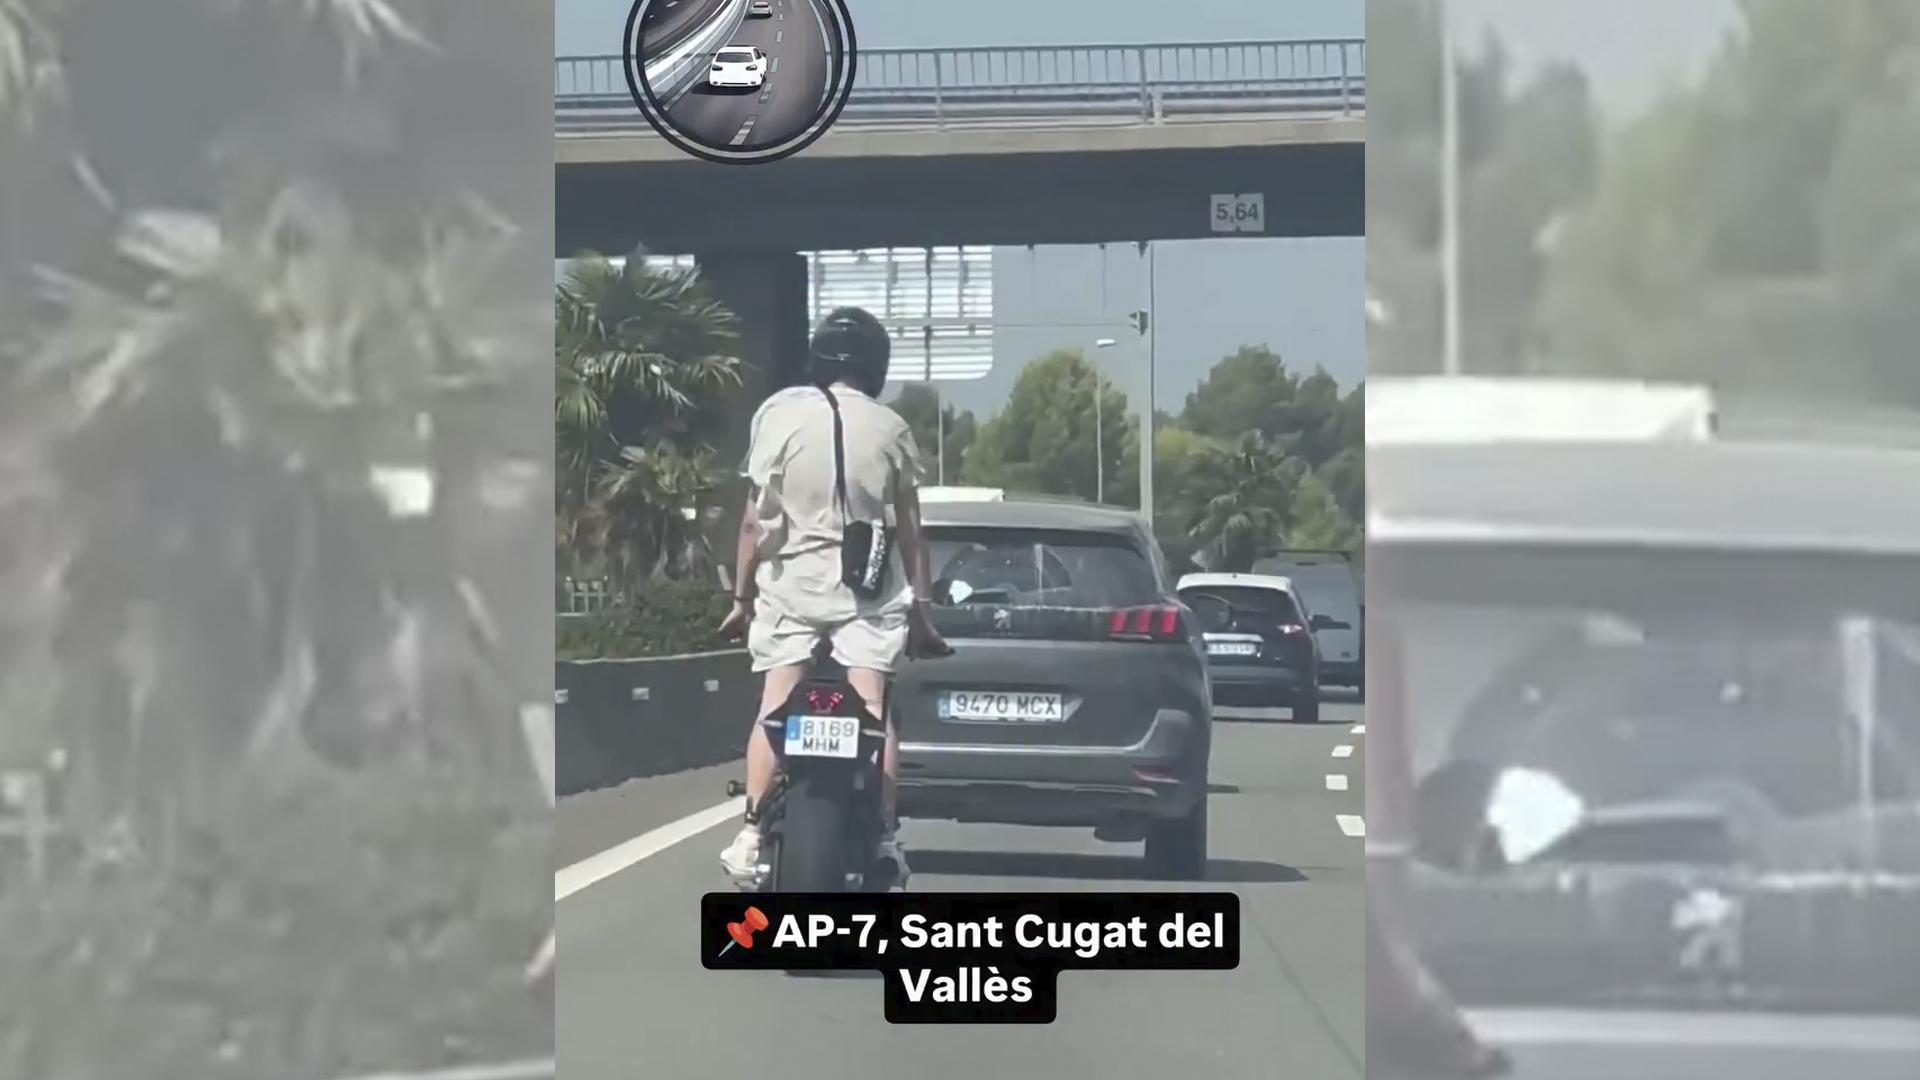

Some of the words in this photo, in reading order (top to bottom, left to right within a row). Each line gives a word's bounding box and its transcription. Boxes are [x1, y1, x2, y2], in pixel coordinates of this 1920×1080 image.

[1216, 202, 1259, 224] 5,64
[956, 693, 1009, 714] 9470
[1017, 695, 1057, 715] MCX
[803, 720, 855, 738] 8169
[802, 737, 840, 752] MHM
